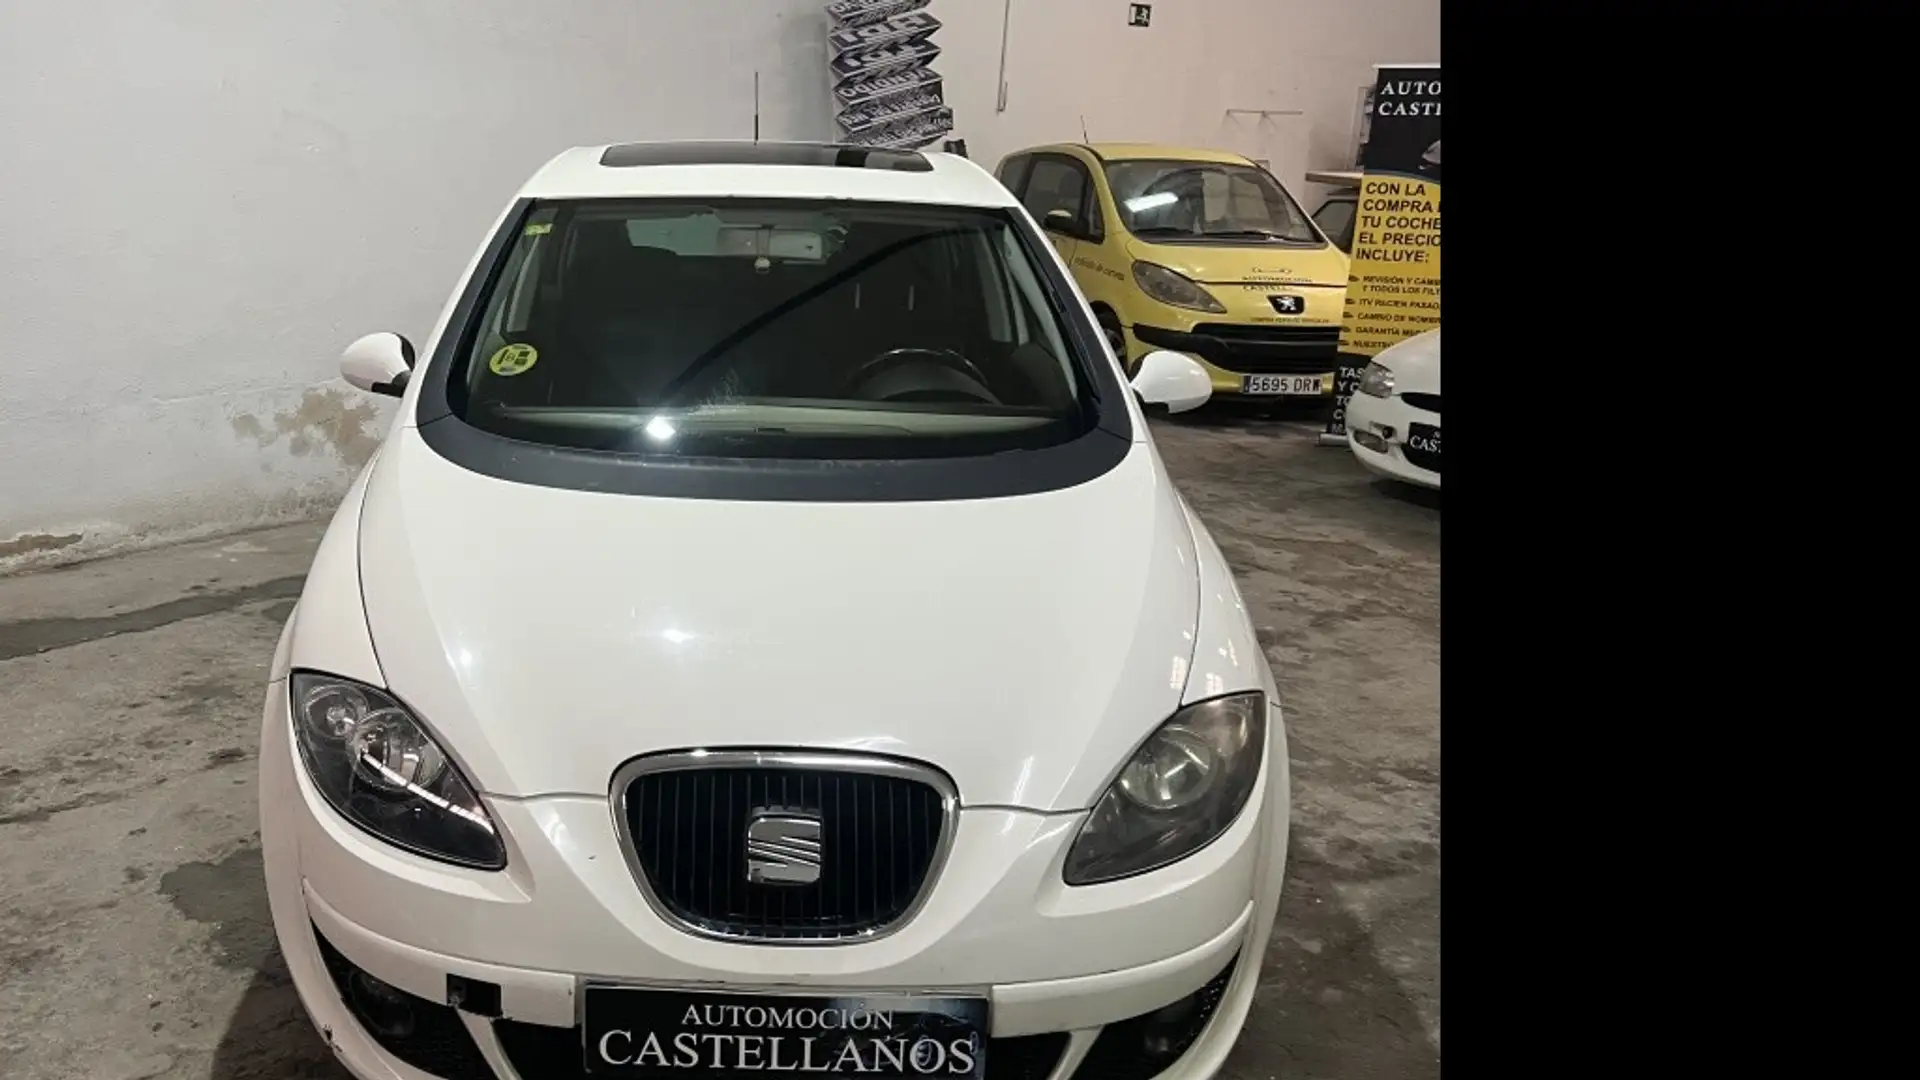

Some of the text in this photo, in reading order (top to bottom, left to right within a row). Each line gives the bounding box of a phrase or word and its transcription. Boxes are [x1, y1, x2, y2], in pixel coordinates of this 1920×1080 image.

[1380, 81, 1440, 95] AUTO
[1366, 182, 1426, 196] CON LA
[1363, 199, 1433, 213] COMPRA
[1362, 216, 1440, 230] TU COCHE
[1360, 232, 1440, 247] EL PRECIO
[1356, 248, 1430, 263] INCLUYE:
[1370, 285, 1400, 293] TODOS
[1394, 314, 1405, 322] DE
[1252, 377, 1288, 391] 5695
[1338, 381, 1347, 392] Y
[681, 1002, 894, 1030] AUTOMOCIÓN
[599, 1028, 976, 1074] CASTELLANOS
